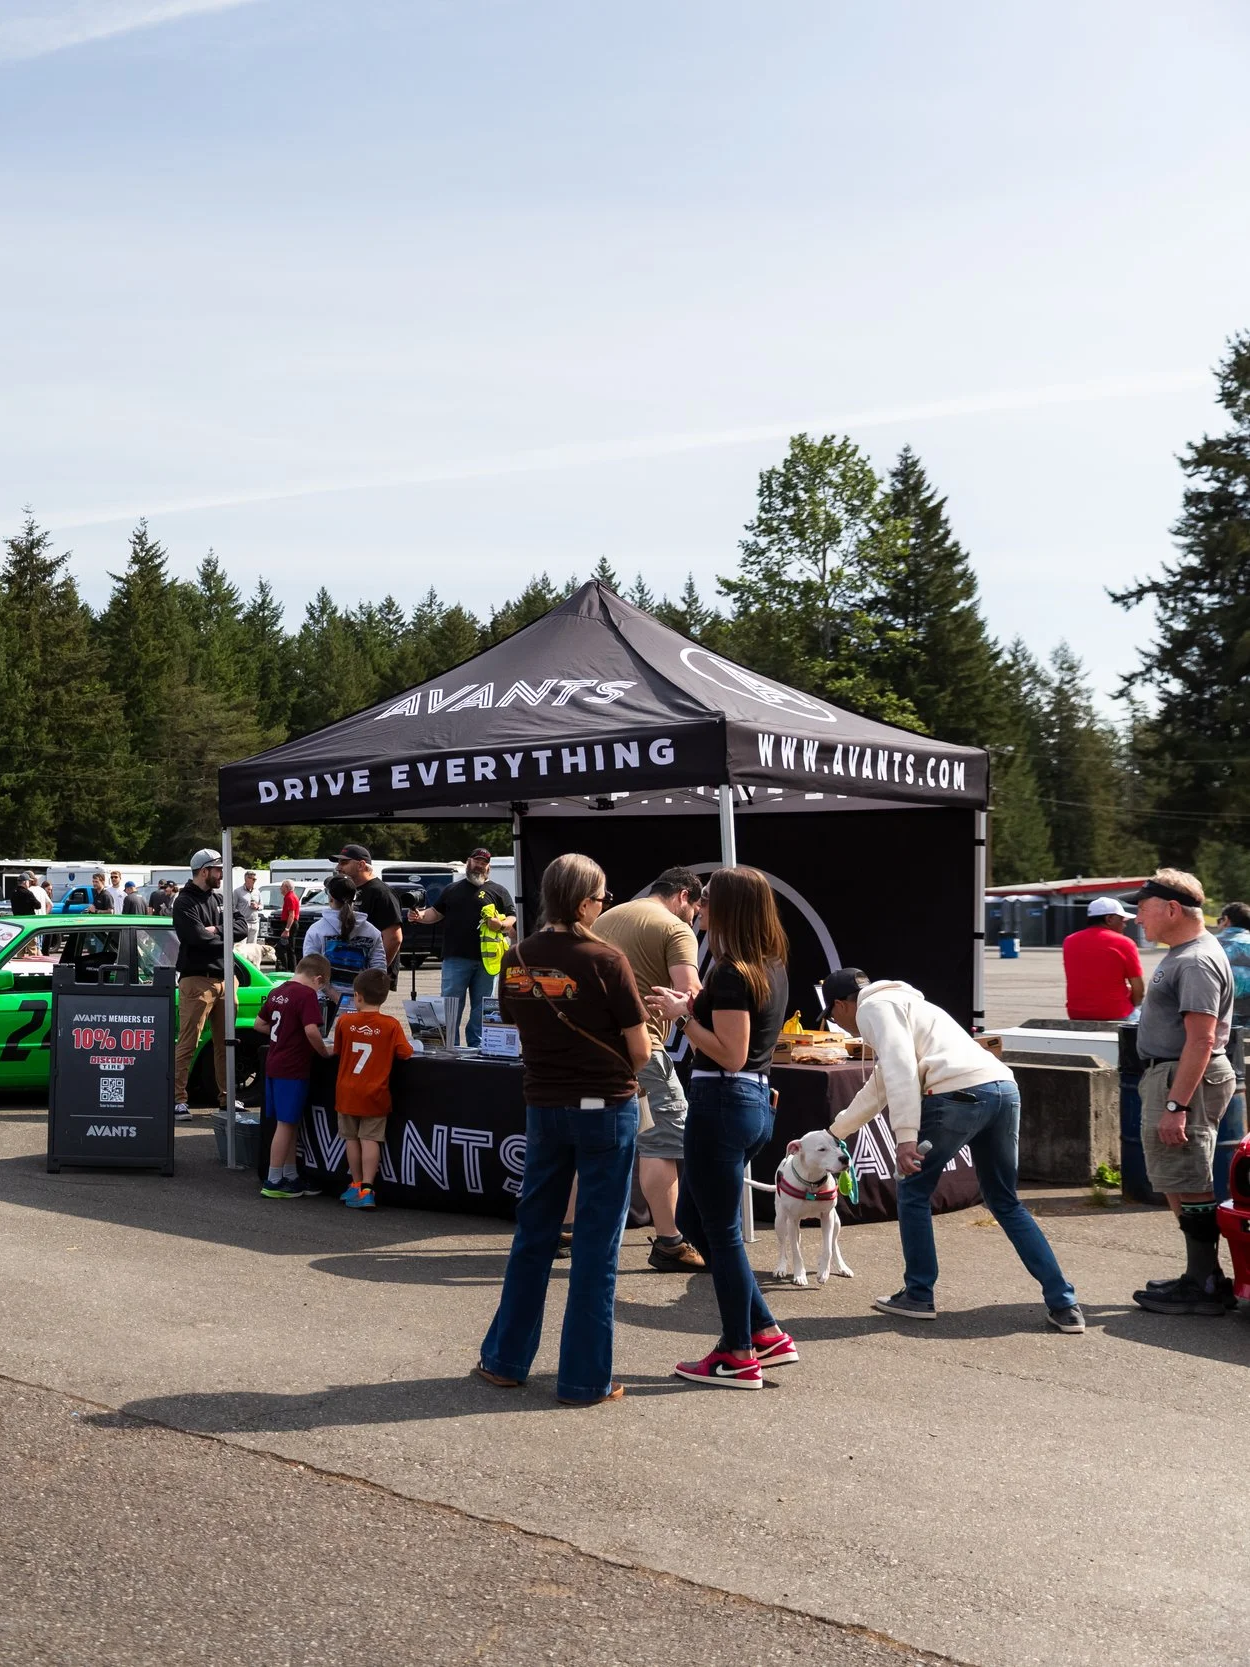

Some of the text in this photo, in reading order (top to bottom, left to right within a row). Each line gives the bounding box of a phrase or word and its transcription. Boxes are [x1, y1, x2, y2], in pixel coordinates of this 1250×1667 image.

[374, 679, 638, 720] AVANTS
[258, 737, 676, 804] DRIVE EVERYTHING
[757, 732, 966, 792] WWW.AVANTS.COM
[73, 1014, 155, 1024] AVANTS MEMBERS GET
[270, 1010, 282, 1043] 2
[72, 1027, 155, 1051] 10% OFF
[90, 1055, 136, 1065] DISCOUNT
[352, 1041, 373, 1075] 7
[86, 1125, 137, 1138] AVANTS
[296, 1105, 529, 1198] VNTS
